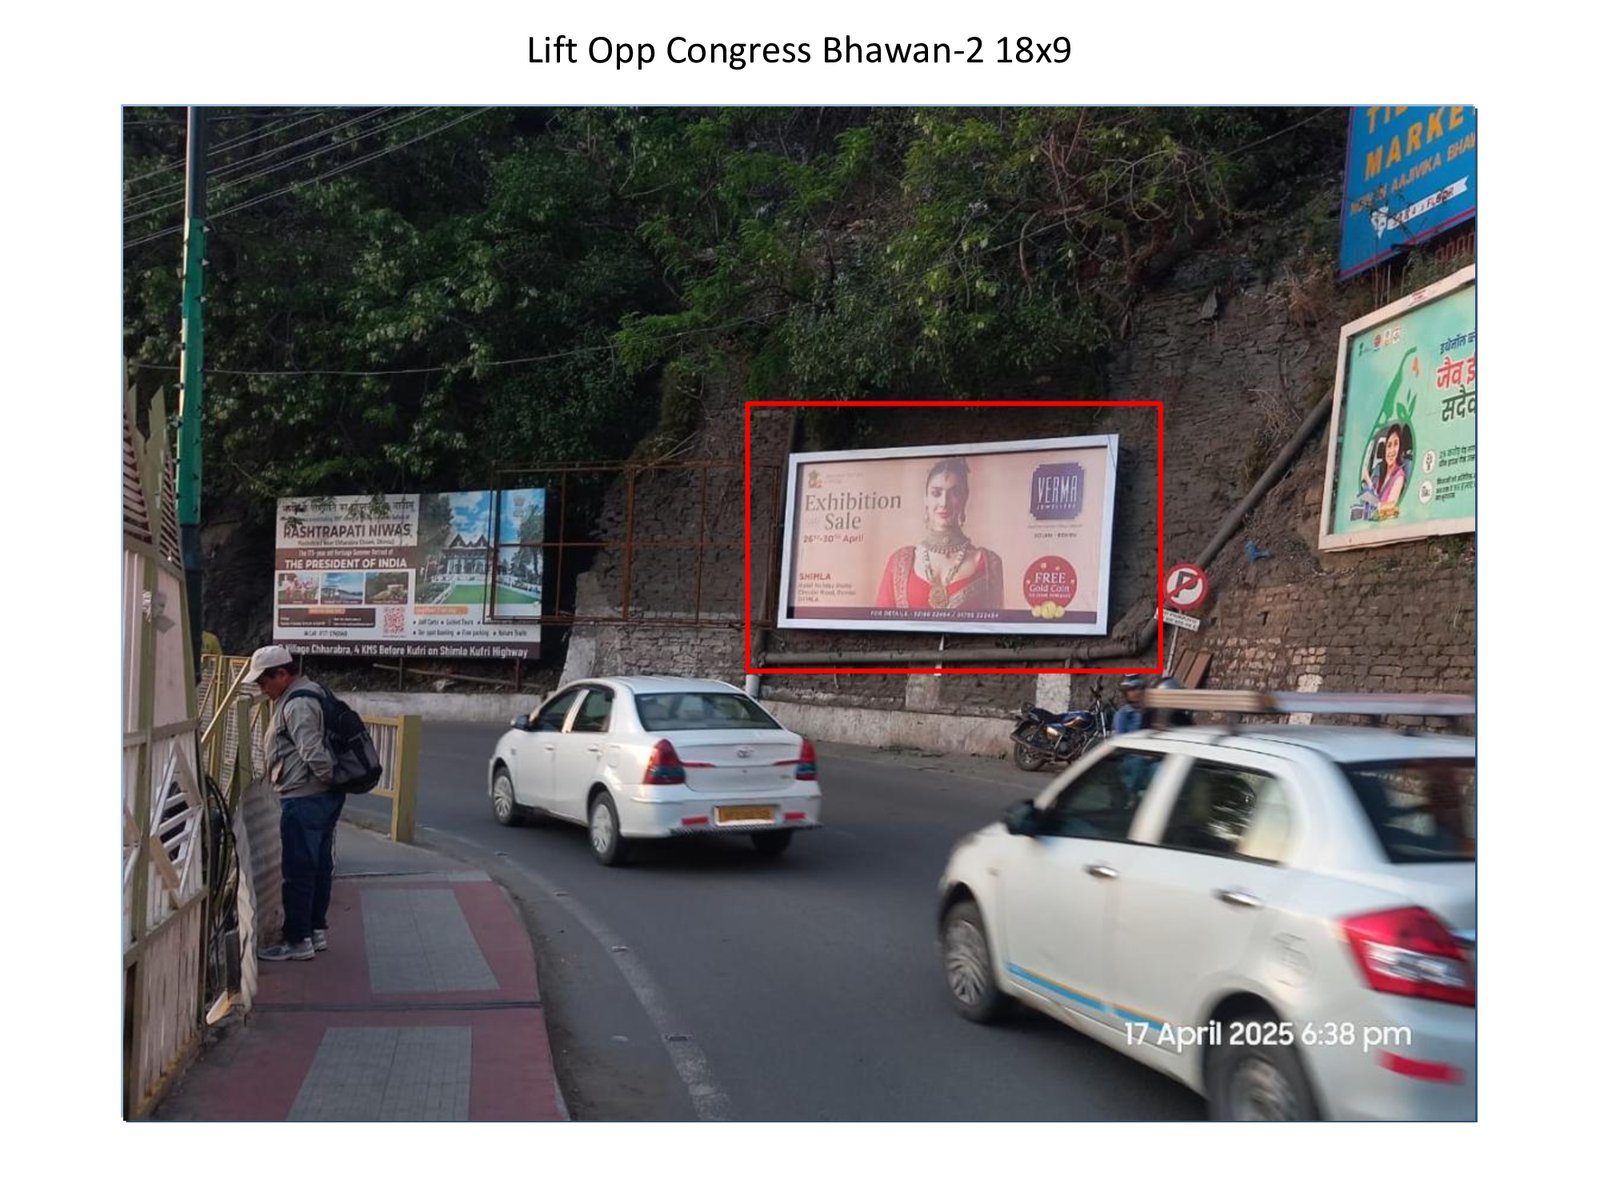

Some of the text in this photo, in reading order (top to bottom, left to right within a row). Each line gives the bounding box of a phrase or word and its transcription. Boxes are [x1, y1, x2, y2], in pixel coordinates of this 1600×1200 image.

[1436, 356, 1464, 389] जैव
[1038, 475, 1078, 504] VERMA
[805, 491, 901, 512] Exhibition
[825, 511, 862, 531] Sale
[283, 523, 412, 539] RASHTRAPATI NIWAS
[842, 534, 864, 544] April
[285, 557, 407, 569] THE PRESIDENT OF INDIA
[799, 572, 832, 581] SHIMLA
[1035, 571, 1066, 584] FREE
[1029, 584, 1070, 593] Gold Coin
[312, 643, 353, 655] Chharabra,
[354, 645, 360, 654] 4
[361, 645, 378, 655] KMS
[380, 645, 405, 655] Before
[407, 645, 426, 655] Kufri
[428, 647, 438, 656] on
[440, 645, 468, 656] Shimla
[470, 646, 491, 657] Kufri
[493, 646, 529, 659] Highway
